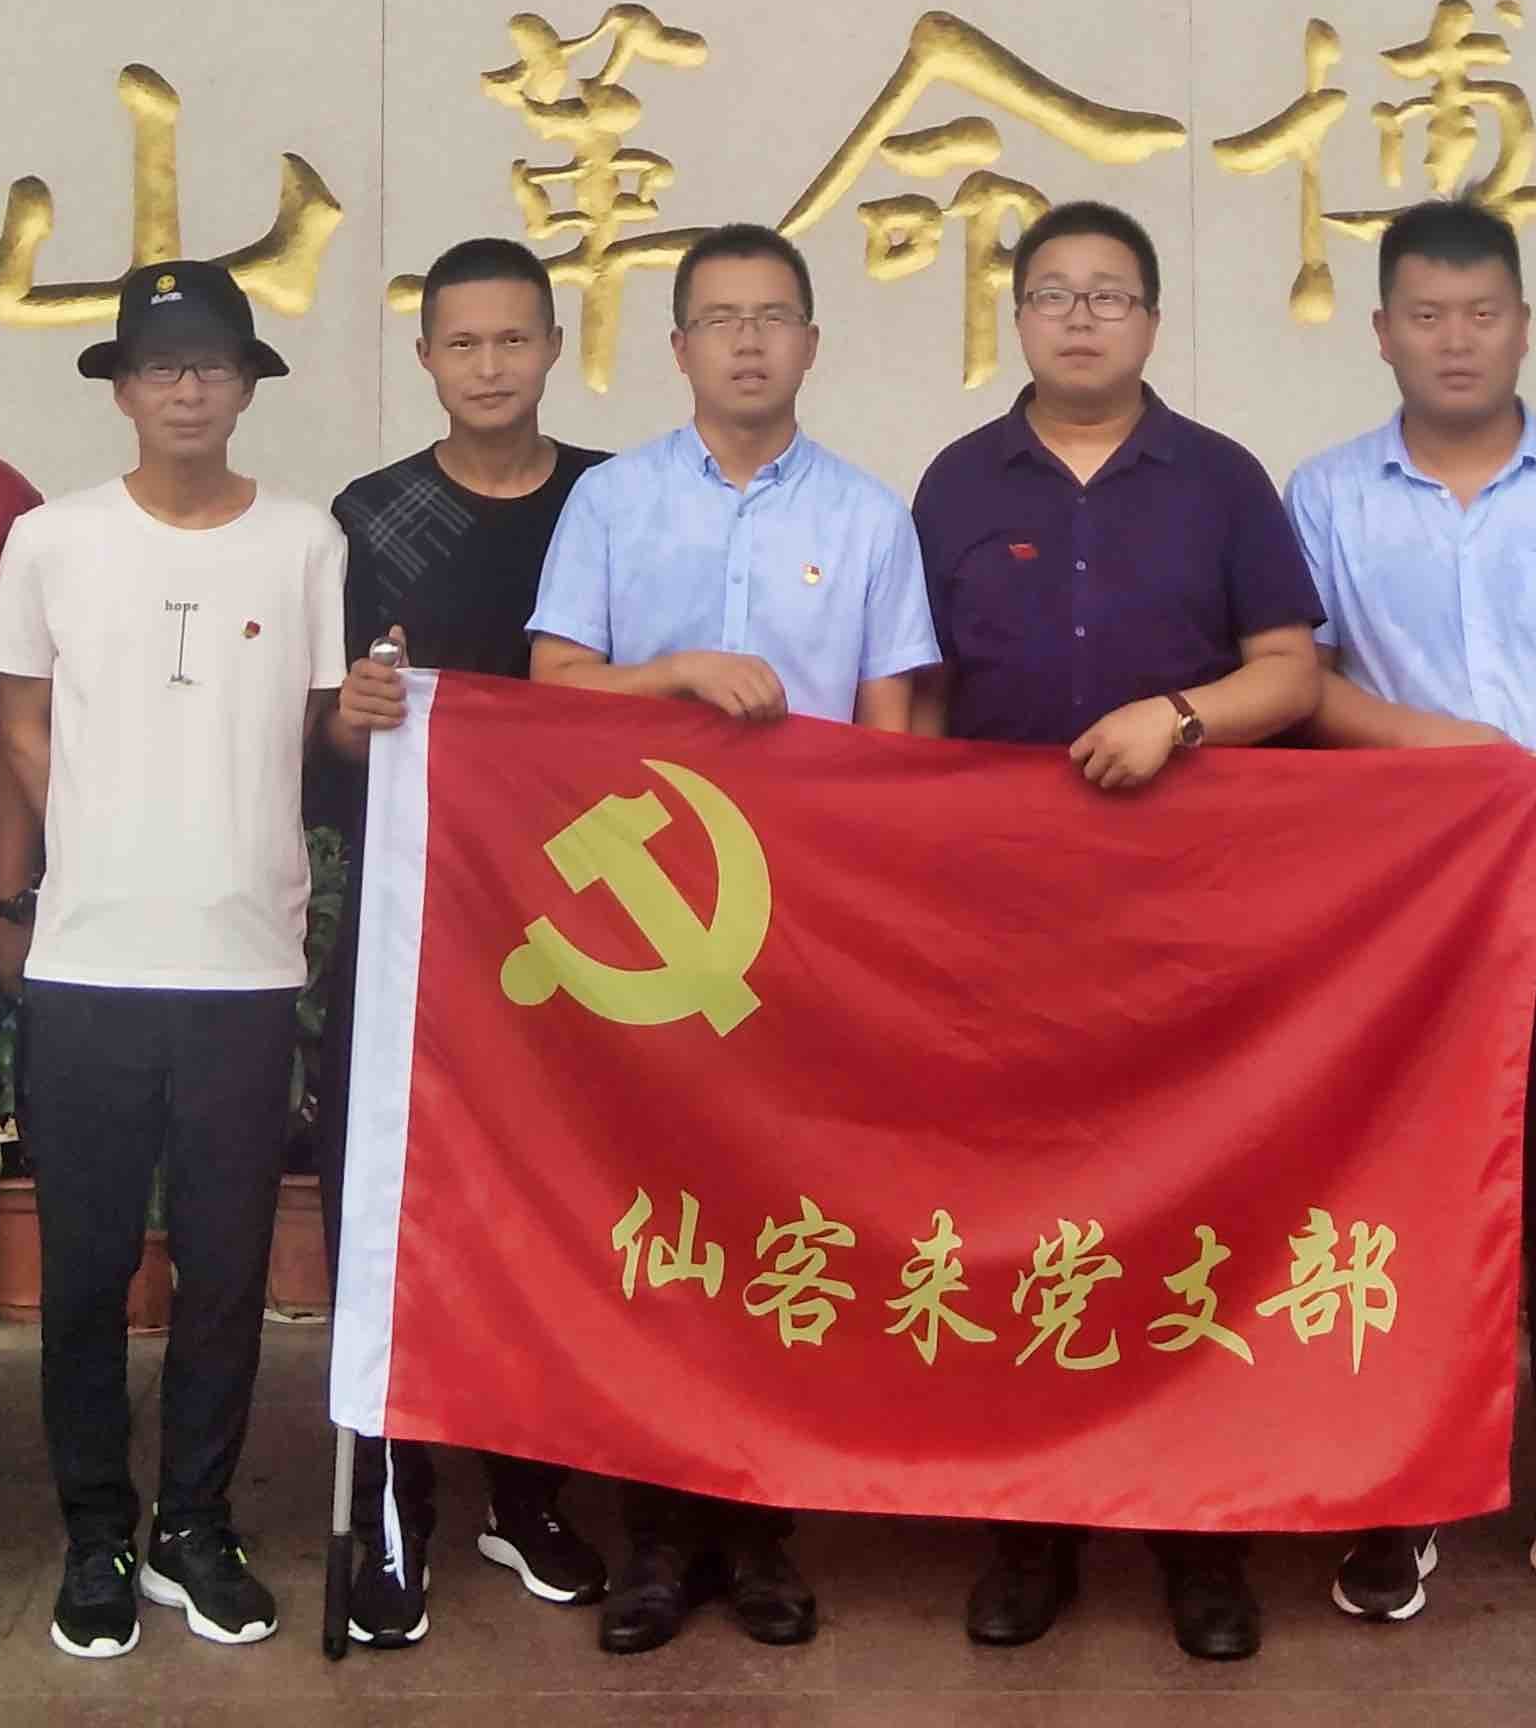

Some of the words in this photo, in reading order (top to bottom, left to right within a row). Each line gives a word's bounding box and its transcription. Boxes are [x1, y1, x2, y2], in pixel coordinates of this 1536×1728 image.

[610, 1184, 1398, 1374] 仙客来党支部
